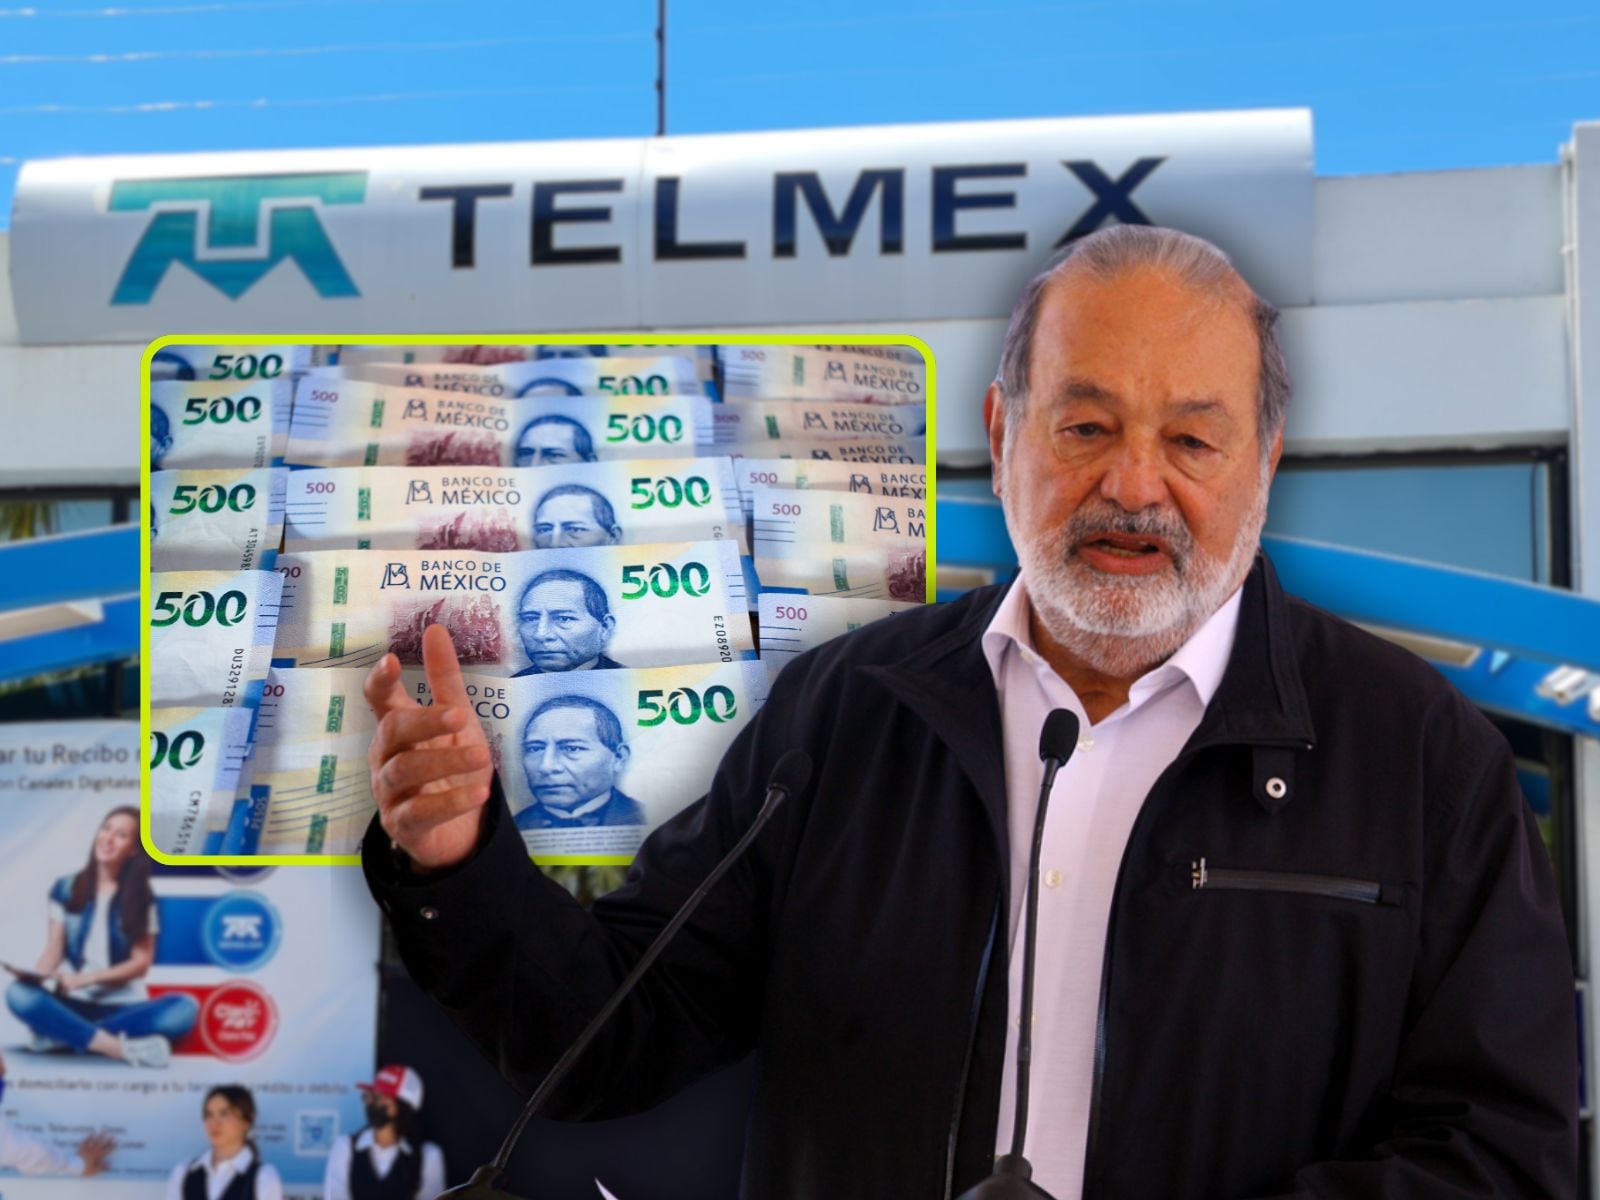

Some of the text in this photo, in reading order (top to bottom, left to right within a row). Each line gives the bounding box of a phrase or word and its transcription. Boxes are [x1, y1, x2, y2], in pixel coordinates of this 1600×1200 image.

[418, 156, 1168, 269] TELMEX
[741, 350, 766, 361] 500
[208, 353, 283, 380] 500
[854, 363, 915, 380] BANCO DE
[434, 373, 500, 383] BANCO DE
[598, 374, 670, 396] 500
[853, 373, 920, 394] MÉXICO
[310, 390, 339, 403] 500
[182, 396, 261, 426] 500
[437, 400, 507, 416] BANCO DE
[831, 411, 876, 420] BANCO
[434, 411, 510, 432] MÉXICO
[605, 414, 683, 443] 500
[834, 420, 904, 434] MÉXICO
[839, 445, 905, 455] BANCO DE
[442, 477, 516, 488] BANCO DE
[750, 472, 778, 484] 500
[305, 481, 336, 495] 500
[442, 487, 521, 506] MÉXICO
[630, 476, 712, 510] 500
[168, 483, 256, 515] 500
[772, 503, 802, 517] 500
[420, 560, 502, 573] BANCO DE
[419, 572, 507, 592] MÉXICO
[621, 562, 711, 600] 500
[150, 590, 247, 627] 500
[775, 606, 808, 621] 500
[222, 648, 245, 708] DU329128
[262, 684, 285, 697] 00
[484, 686, 506, 699] DE
[636, 684, 738, 728] 500
[24, 746, 46, 764] tu
[52, 744, 129, 764] Recibo
